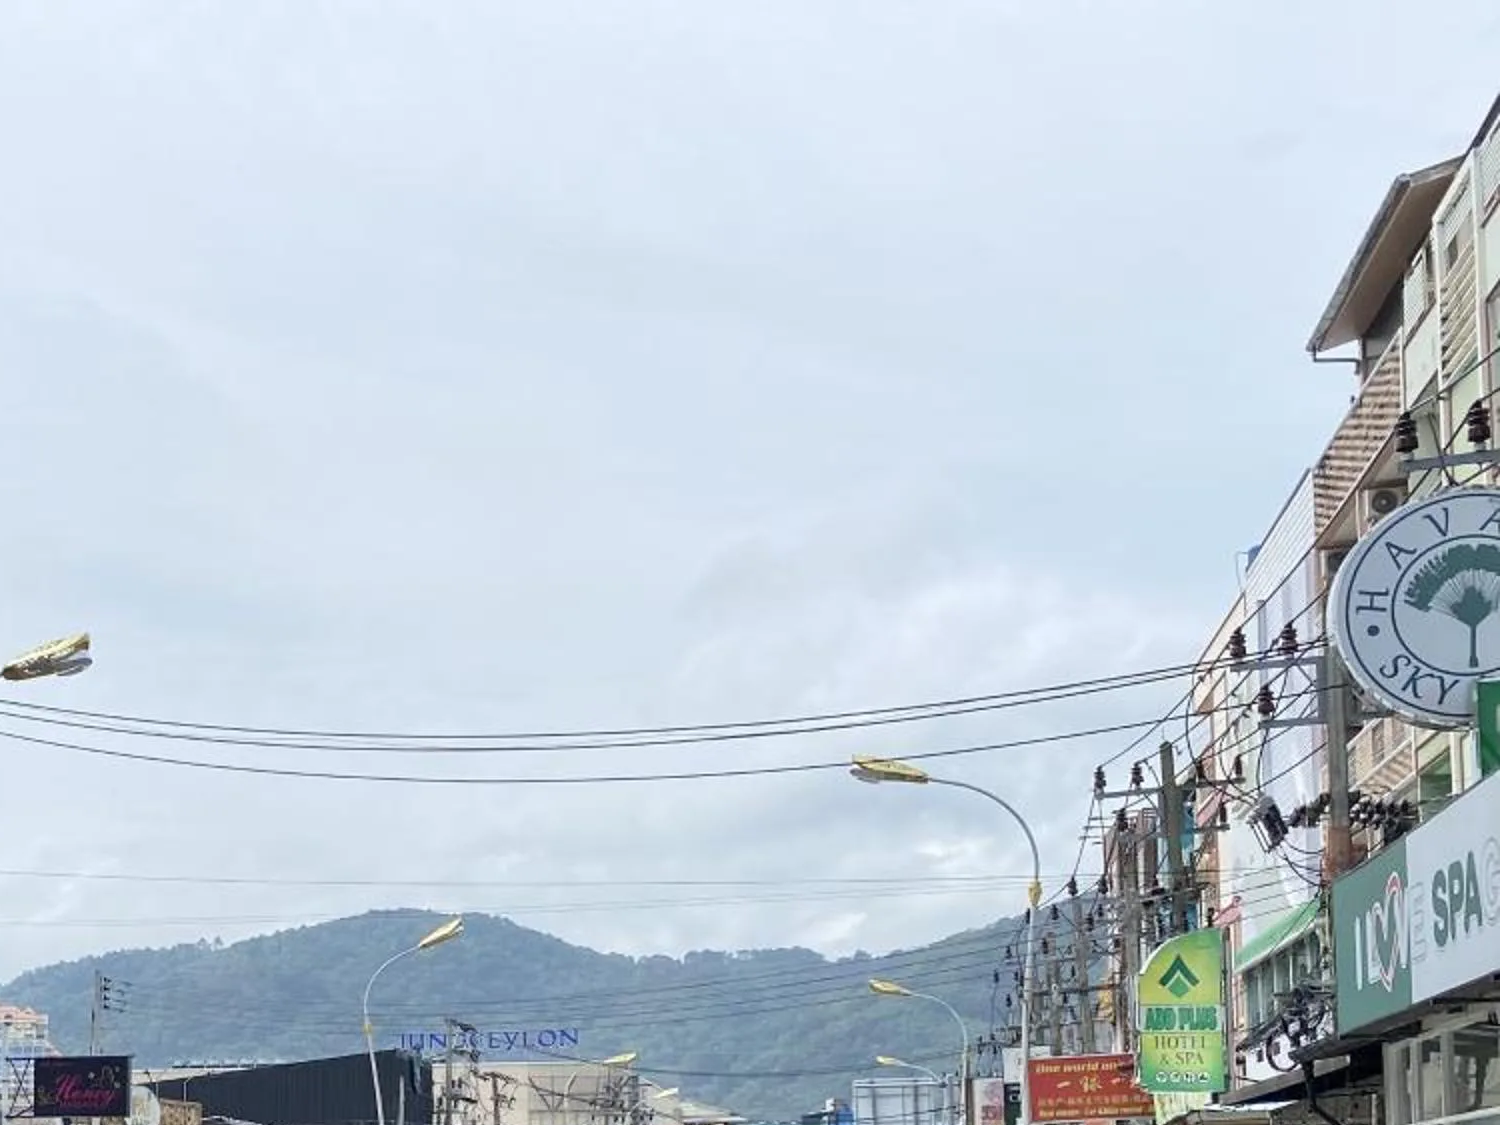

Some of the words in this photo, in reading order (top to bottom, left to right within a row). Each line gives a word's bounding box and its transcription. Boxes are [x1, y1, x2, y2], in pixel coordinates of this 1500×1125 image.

[1379, 654, 1461, 705] SKY
[1431, 850, 1483, 948] SPA
[1175, 1051, 1205, 1065] SPA
